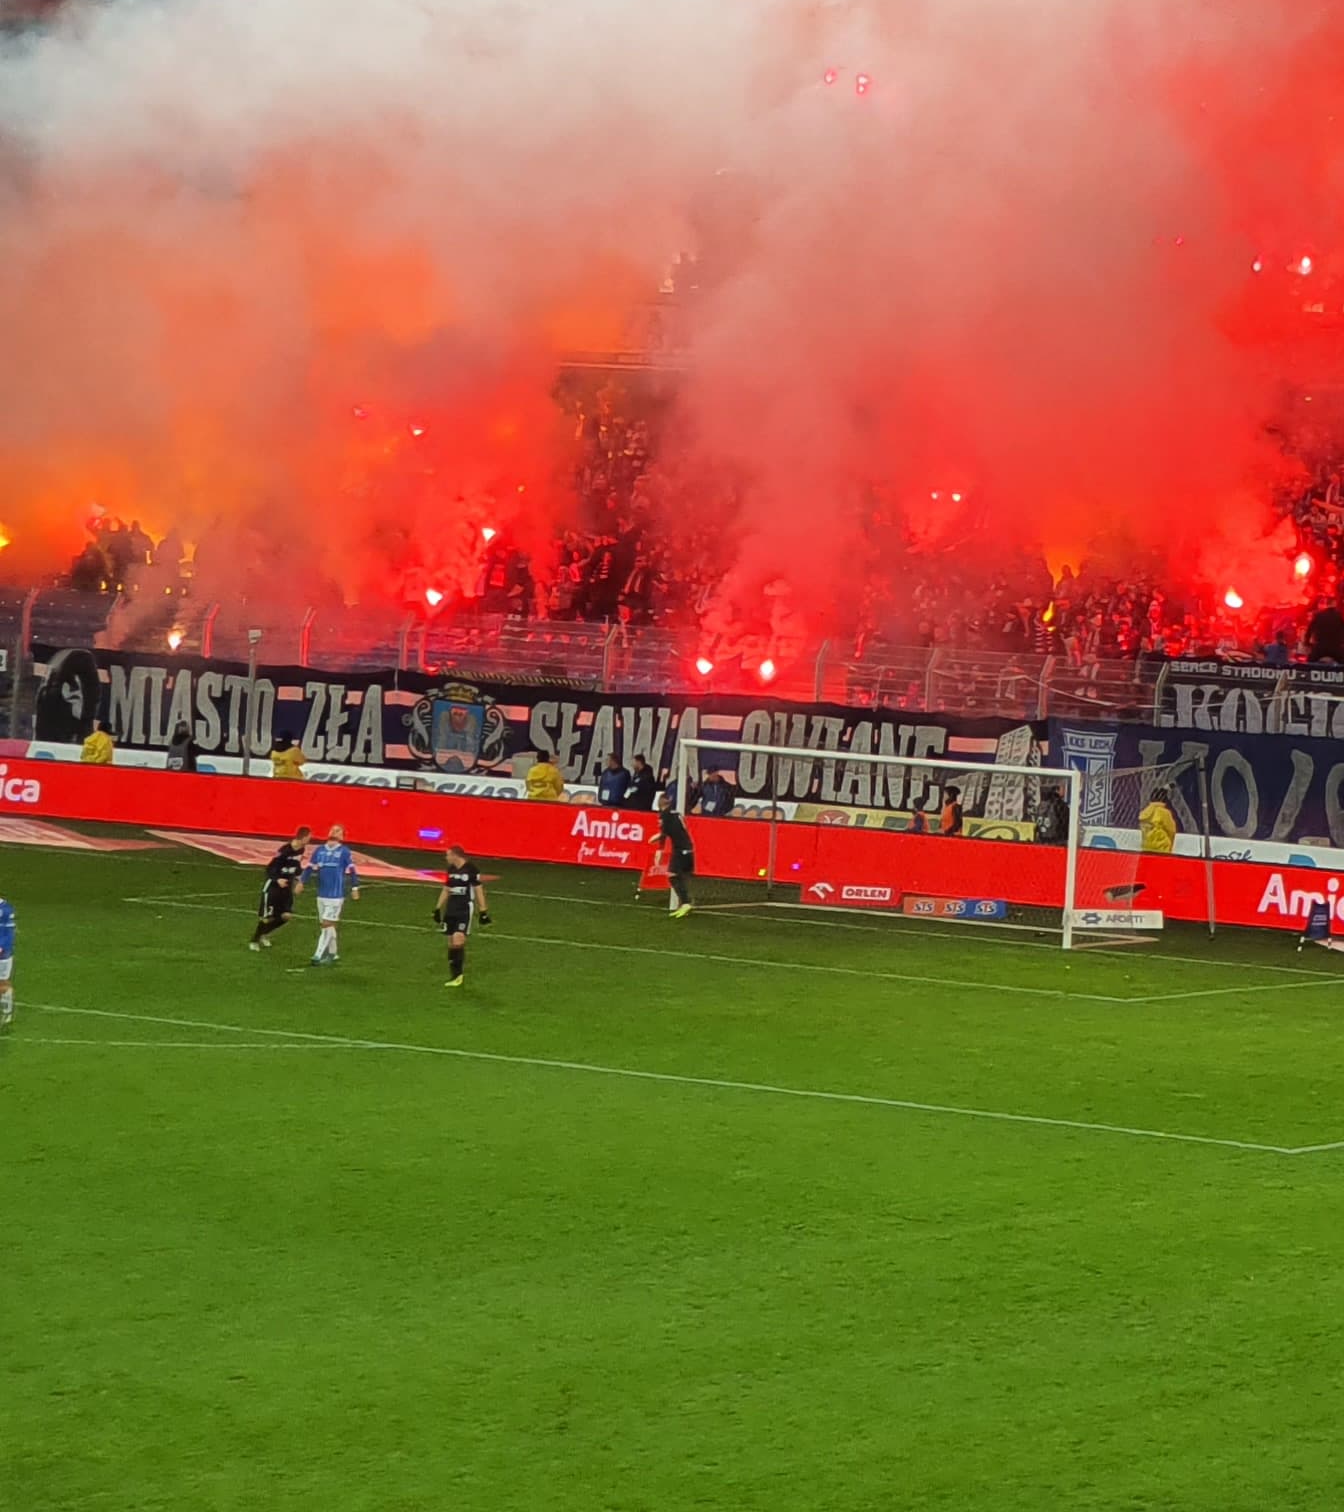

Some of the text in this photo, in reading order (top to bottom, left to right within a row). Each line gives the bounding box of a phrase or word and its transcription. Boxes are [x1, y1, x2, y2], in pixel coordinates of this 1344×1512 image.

[1171, 661, 1217, 674] SERCE
[109, 664, 276, 756] MIASTO
[301, 681, 385, 764] ZŁA
[571, 810, 644, 842] Amica
[577, 841, 596, 864] for
[844, 888, 888, 899] ORLEN
